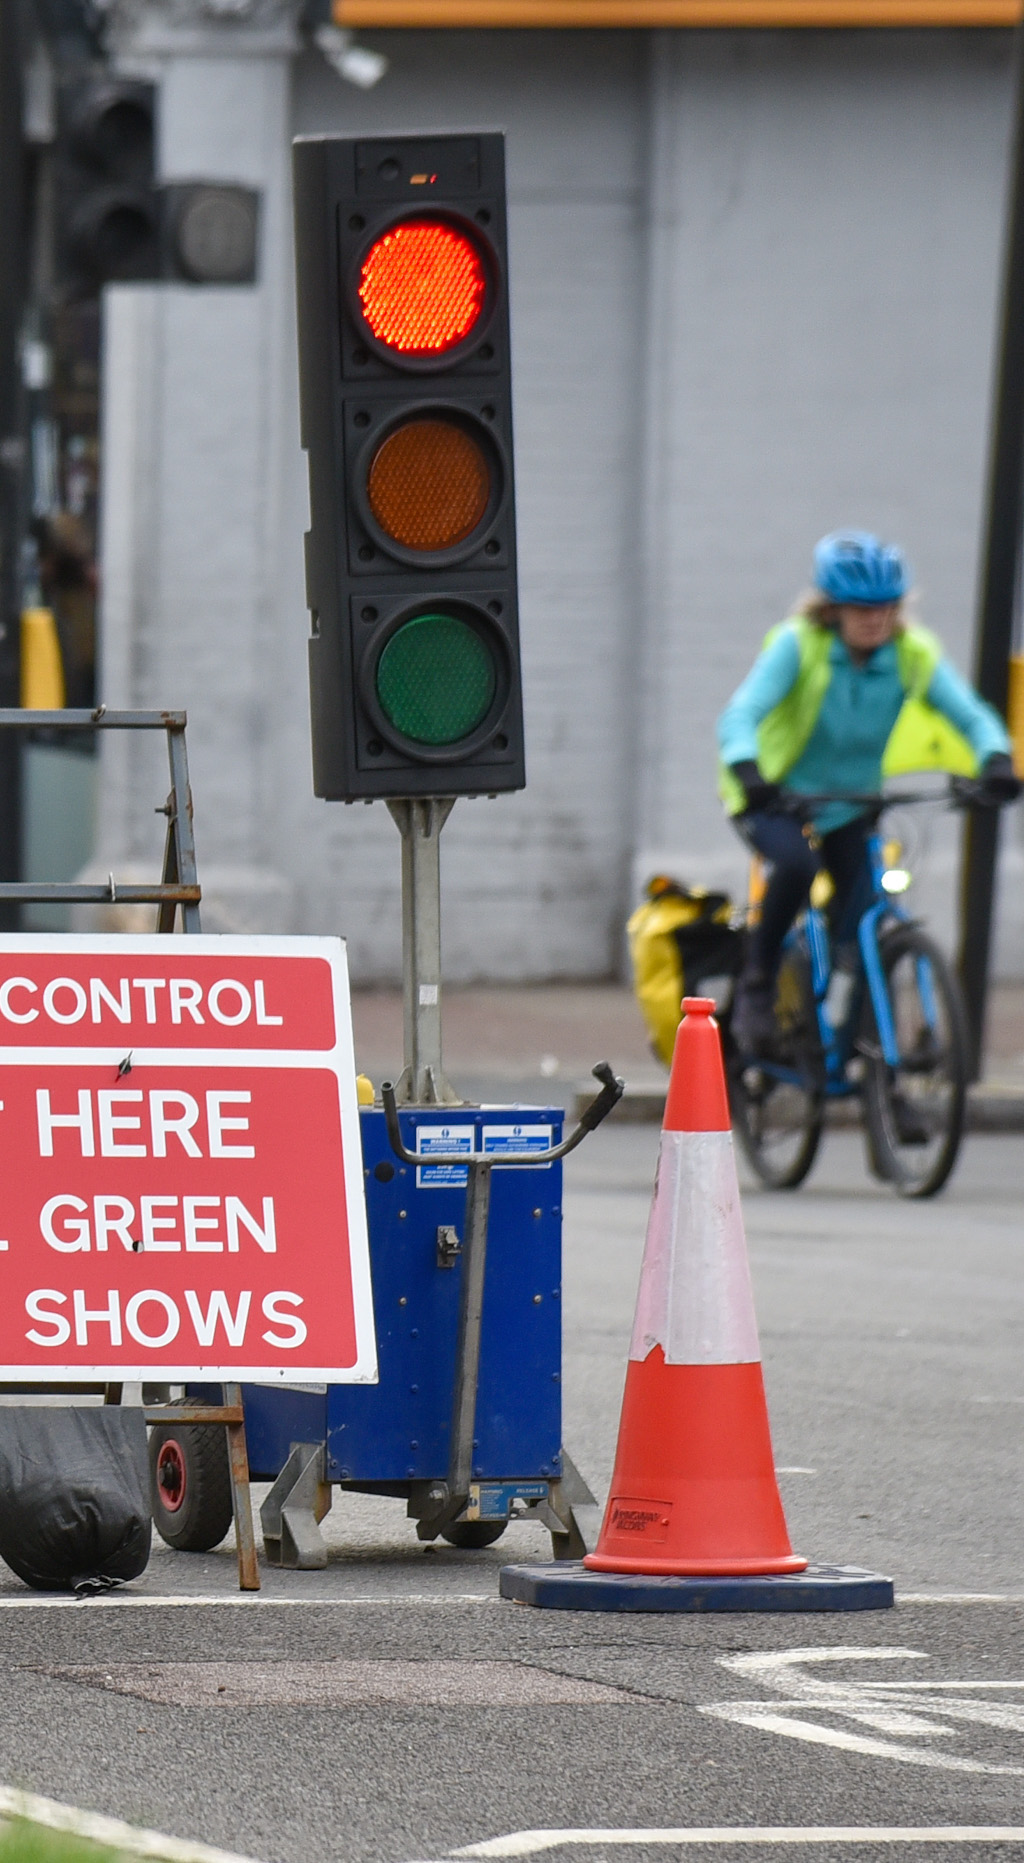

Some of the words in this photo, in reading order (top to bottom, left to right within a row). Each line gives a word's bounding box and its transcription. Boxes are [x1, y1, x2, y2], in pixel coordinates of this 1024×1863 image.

[36, 1088, 256, 1159] HERE
[39, 1194, 277, 1254] GREEN
[25, 1288, 308, 1349] SHOWS
